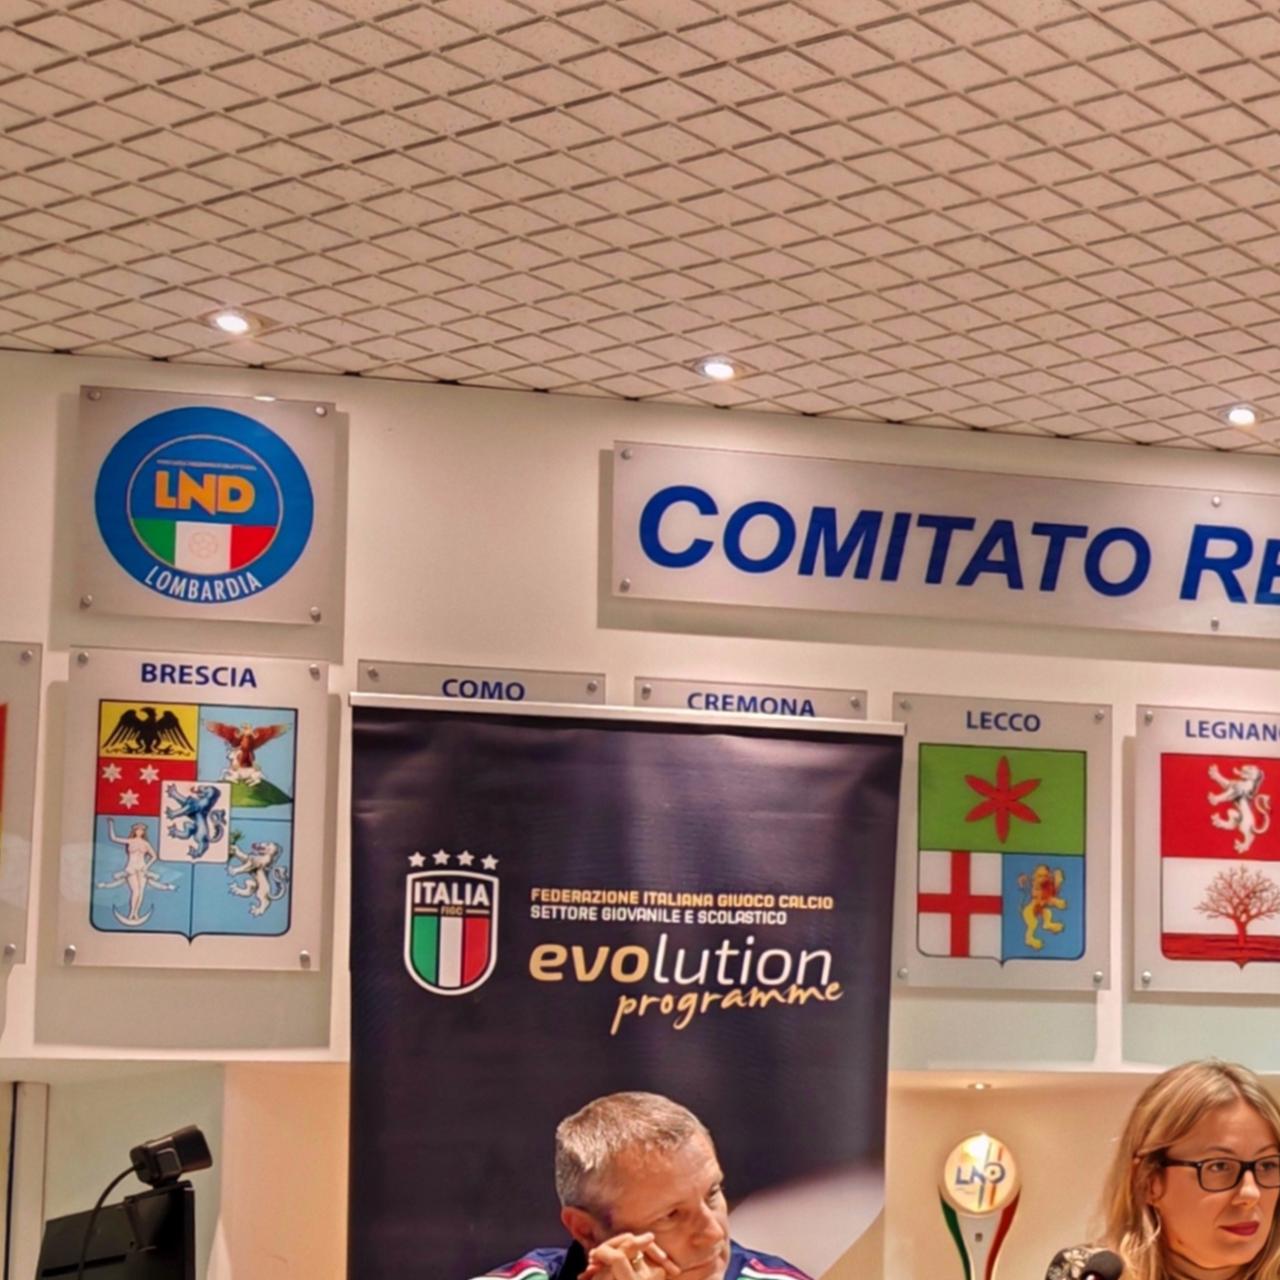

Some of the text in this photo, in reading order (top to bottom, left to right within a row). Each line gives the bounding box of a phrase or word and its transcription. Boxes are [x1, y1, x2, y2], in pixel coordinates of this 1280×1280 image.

[154, 469, 255, 515] LND
[639, 485, 1150, 597] COMITATO
[145, 565, 262, 601] LOMBARDIA
[140, 663, 257, 688] BRESCIA
[442, 678, 526, 701] COMO
[687, 692, 815, 718] CREMONA
[966, 710, 1041, 733] LECCO
[414, 882, 490, 906] ITALIA
[531, 888, 834, 910] FEDERAZIONE ITALIANA GIUOCO CALCIO
[530, 906, 787, 925] SETTORE GIOVANILE E SCOLASTICO
[528, 934, 832, 987] evolution
[610, 978, 845, 1036] programme
